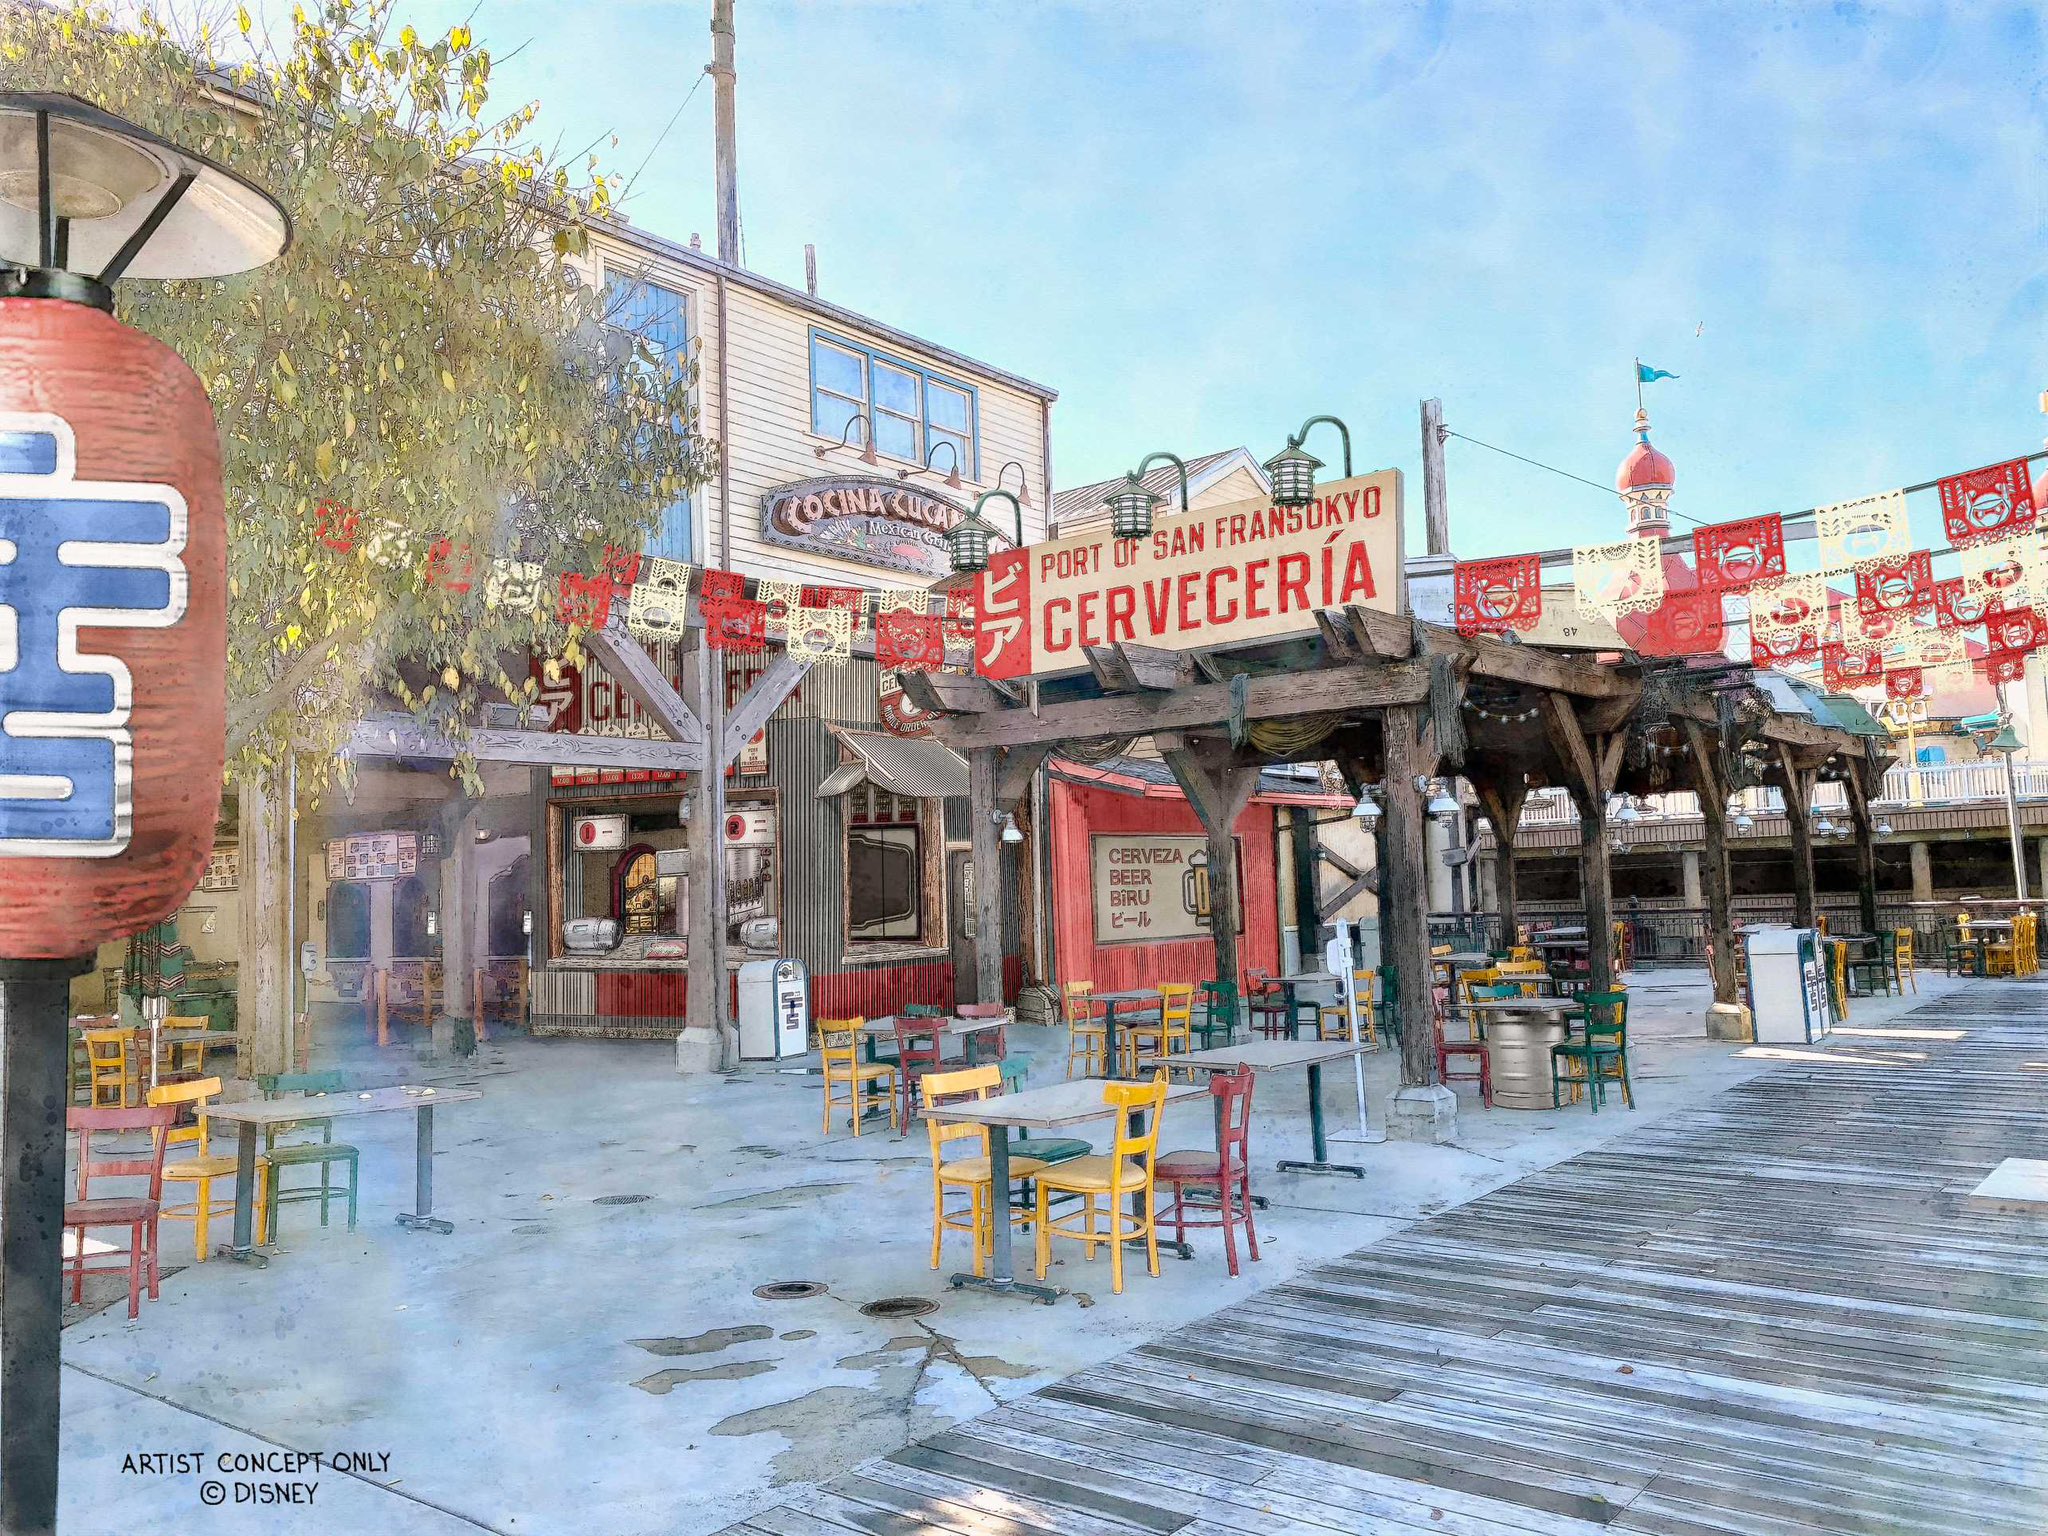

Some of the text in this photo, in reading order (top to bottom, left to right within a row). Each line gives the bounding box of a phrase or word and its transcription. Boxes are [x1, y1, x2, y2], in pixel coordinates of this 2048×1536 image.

[787, 487, 887, 534] COCINA
[868, 521, 921, 541] Mexican
[1041, 485, 1382, 583] PORT OF SAN FRANSOKYO
[1043, 528, 1378, 654] CERVECERÍA
[981, 561, 1024, 668] ビア
[884, 704, 927, 732] MOBILE ORDER
[729, 821, 740, 835] 2
[1108, 847, 1184, 865] CERVEZA
[1109, 868, 1153, 886] BEER
[1111, 911, 1152, 929] ビール
